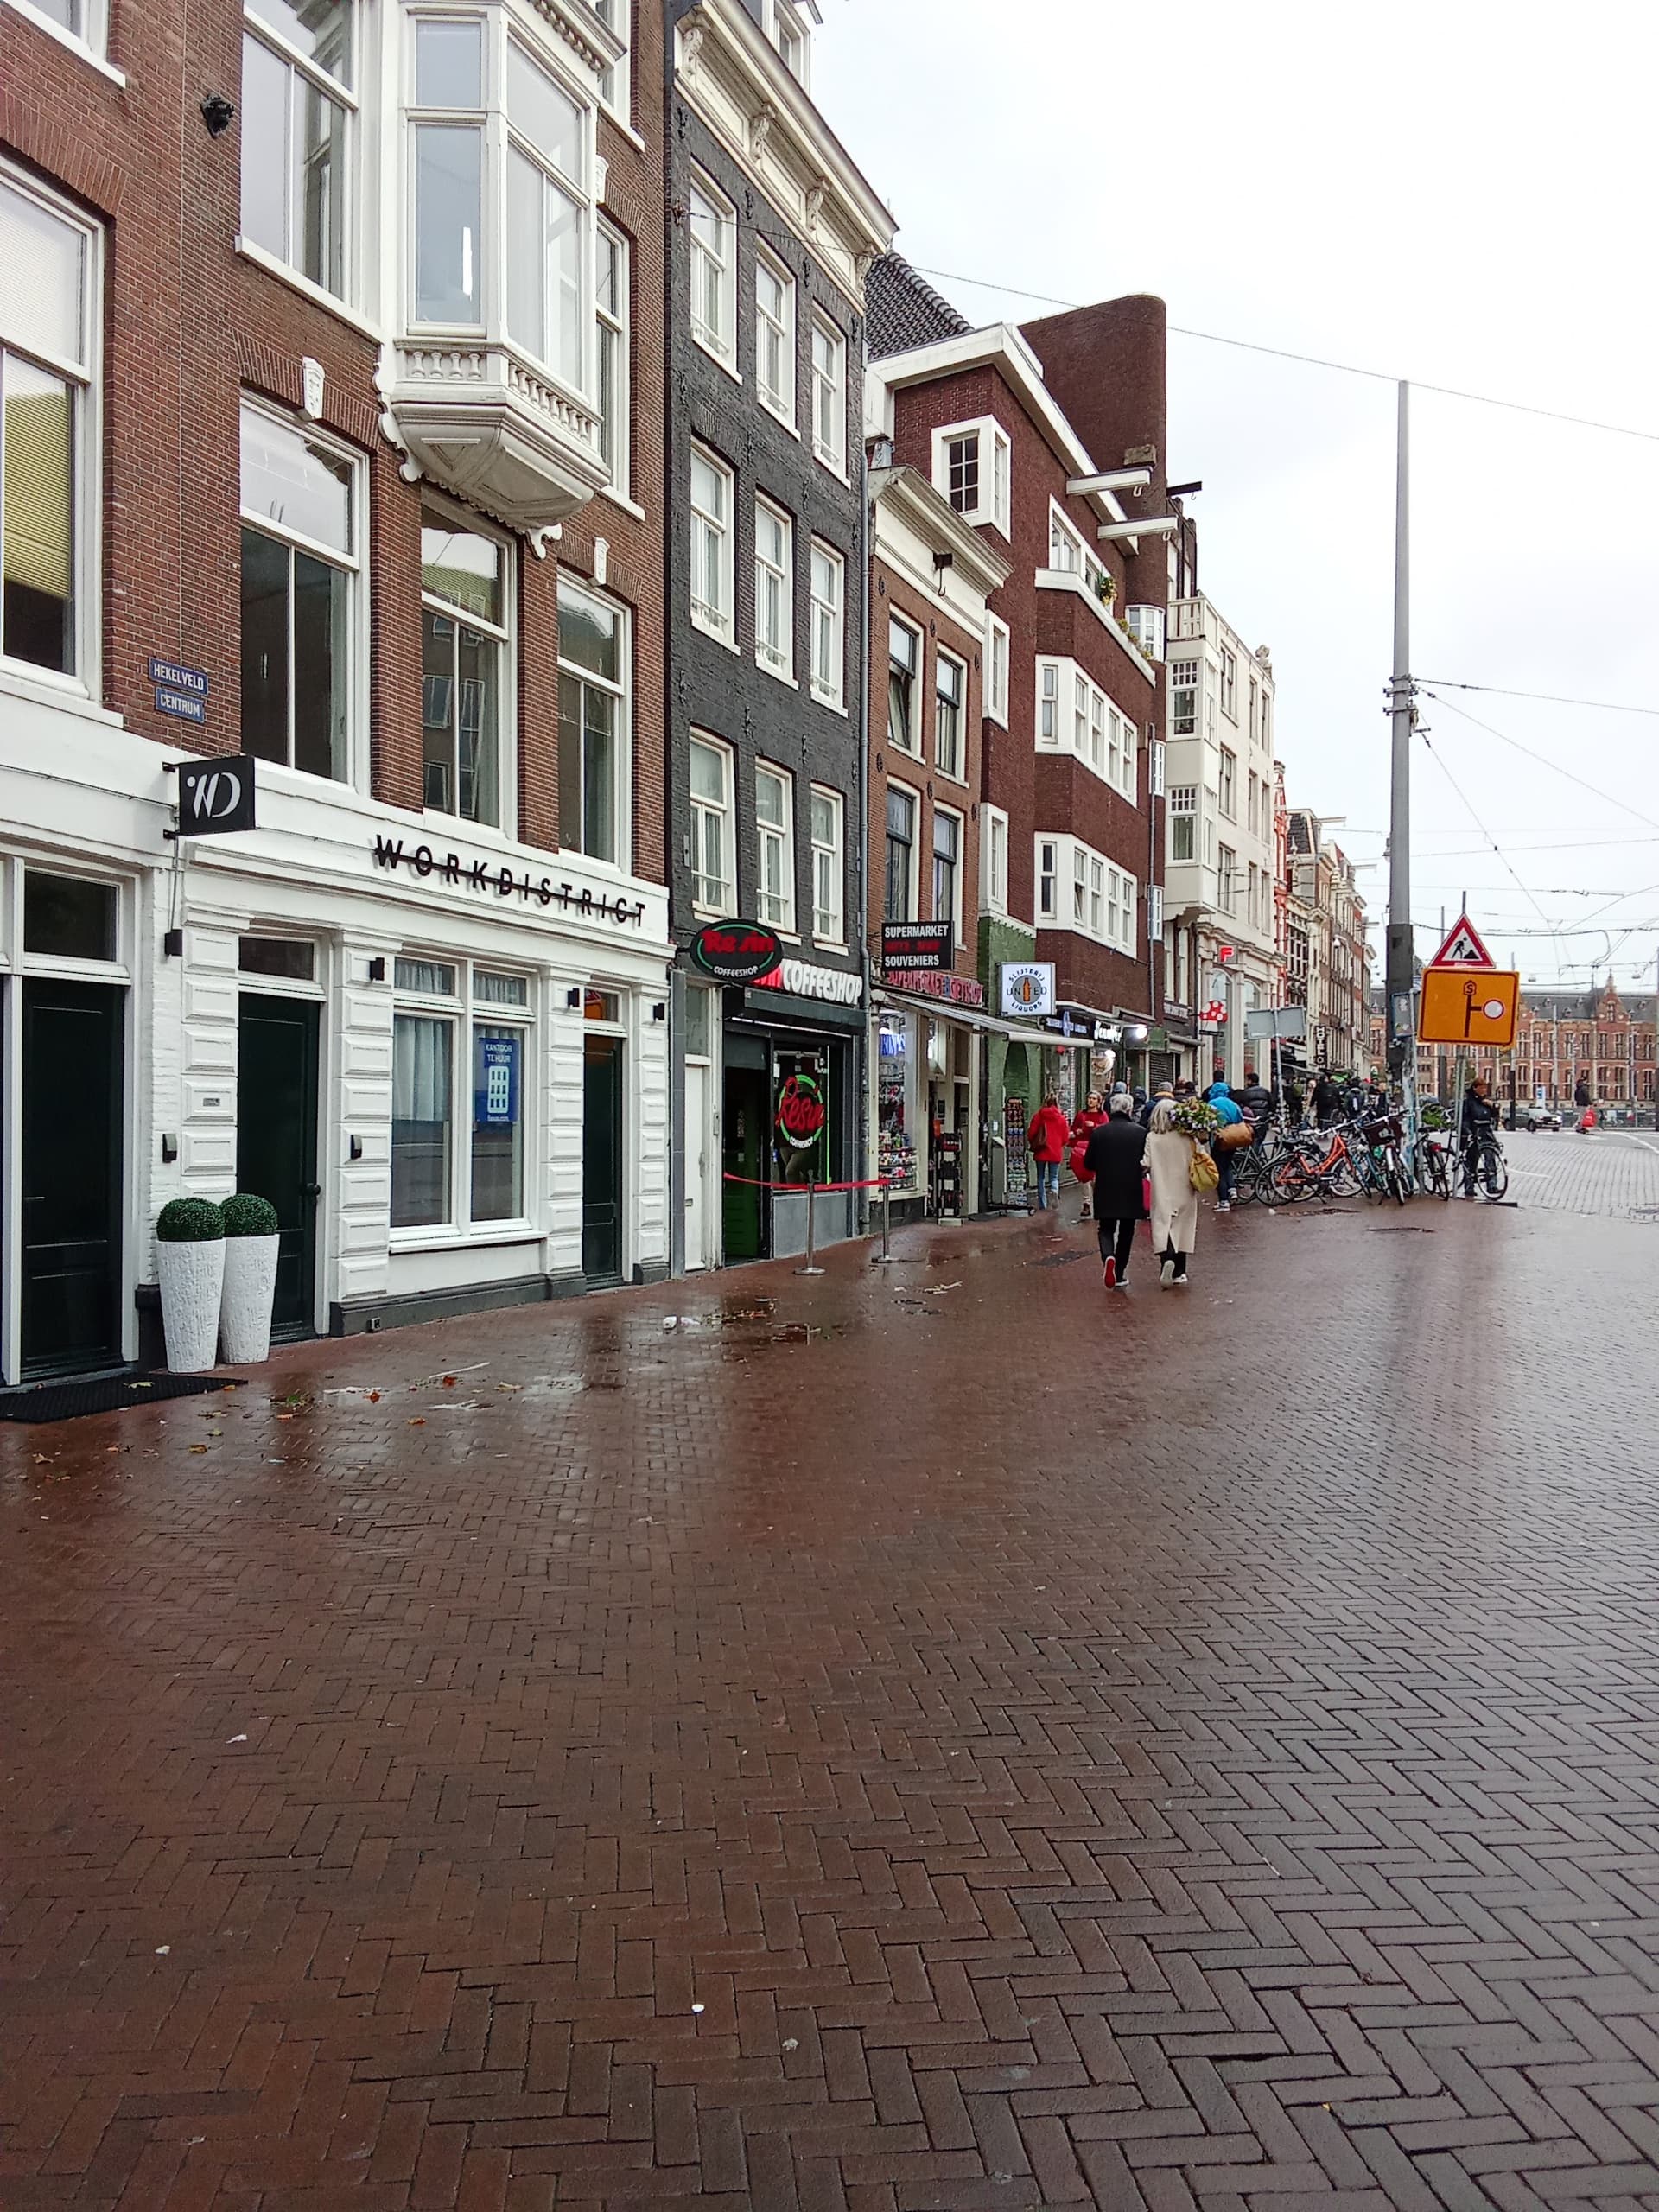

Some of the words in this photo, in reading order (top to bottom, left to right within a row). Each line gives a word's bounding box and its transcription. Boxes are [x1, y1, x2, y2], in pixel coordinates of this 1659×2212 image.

[154, 664, 204, 690] HEKELVELD
[160, 693, 201, 717] CENTRUM
[374, 835, 645, 926] WORKDISTRICT
[884, 925, 949, 938] SUPERMARKET
[884, 955, 939, 967] SOUVENIERS
[714, 965, 759, 977] COFFEESHOP
[1008, 968, 1046, 982] SLIJTERIJ
[783, 960, 863, 1006] COFFEESHOP
[1466, 984, 1473, 994] S
[1006, 987, 1047, 996] UNED
[1011, 1001, 1042, 1012] LIQUORS
[1316, 1027, 1325, 1055] HOTEL
[486, 1044, 512, 1052] KANTOOR
